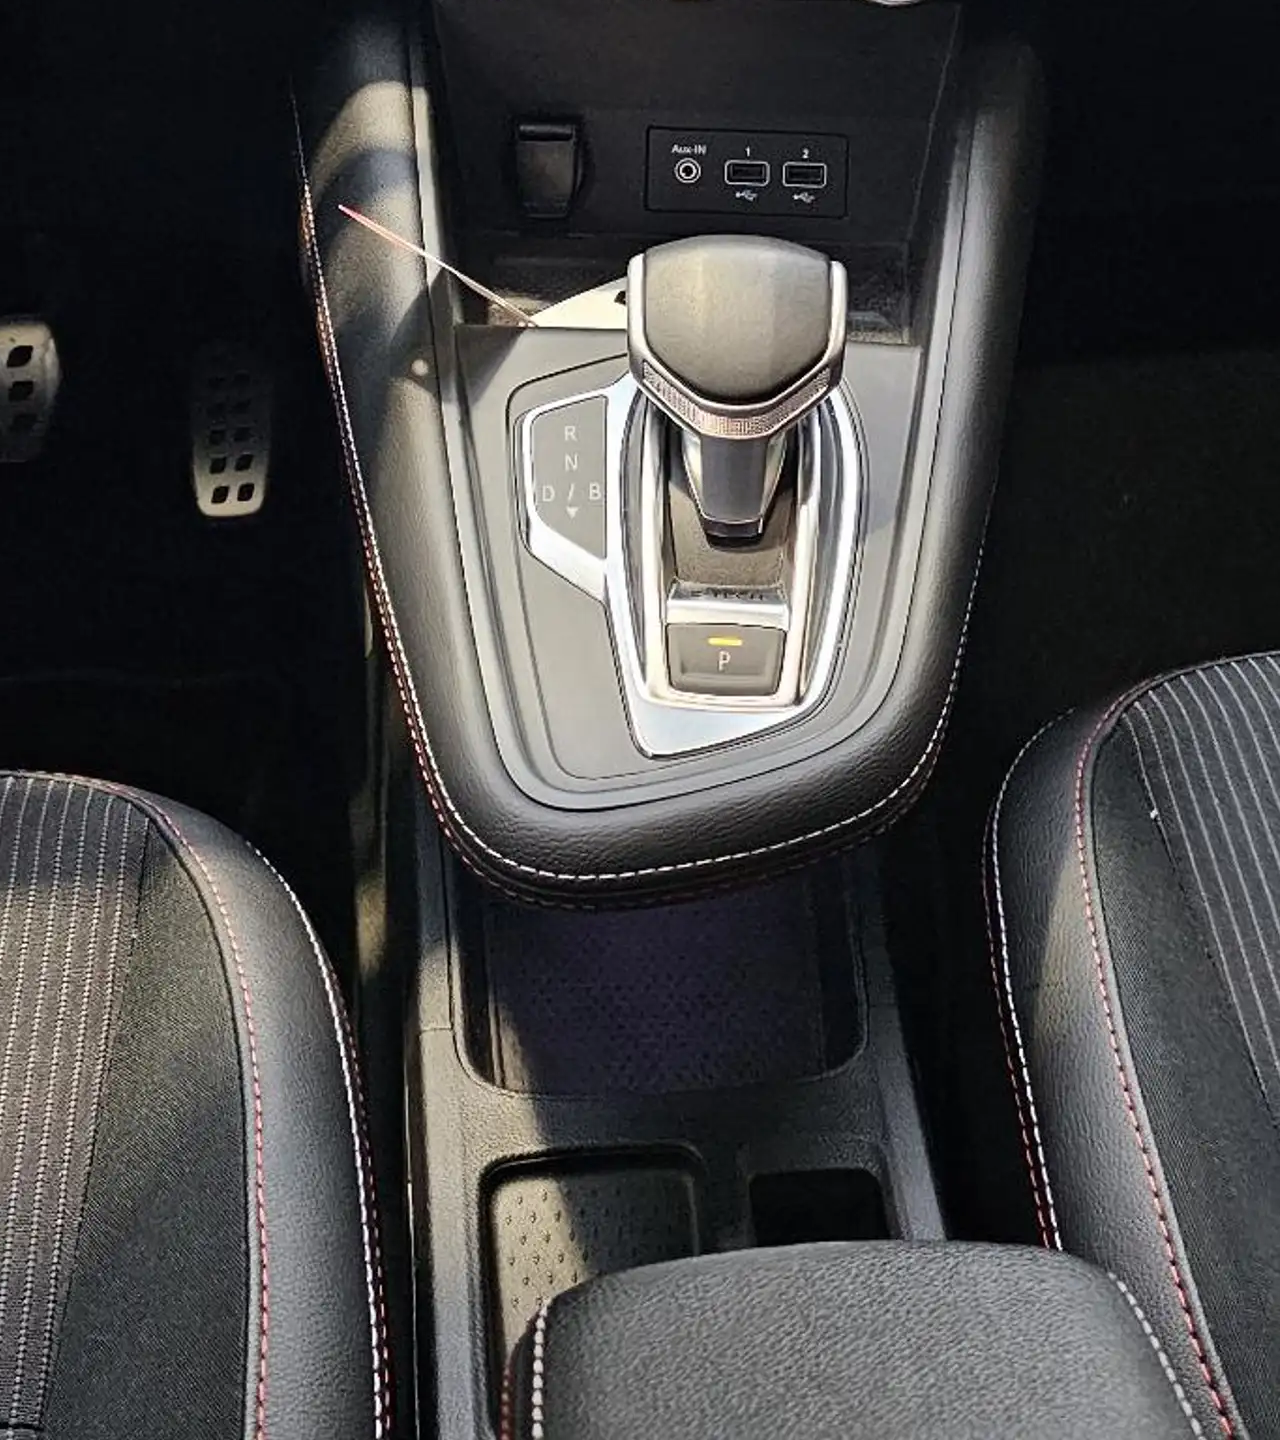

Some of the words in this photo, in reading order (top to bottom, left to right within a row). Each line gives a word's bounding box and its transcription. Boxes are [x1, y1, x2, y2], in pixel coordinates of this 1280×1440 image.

[671, 143, 707, 155] Aux-IN
[745, 146, 751, 157] 1
[802, 148, 810, 159] 2
[564, 425, 577, 441] R
[565, 453, 578, 472] N
[542, 485, 556, 502] D
[588, 481, 602, 501] B
[718, 649, 732, 672] P
